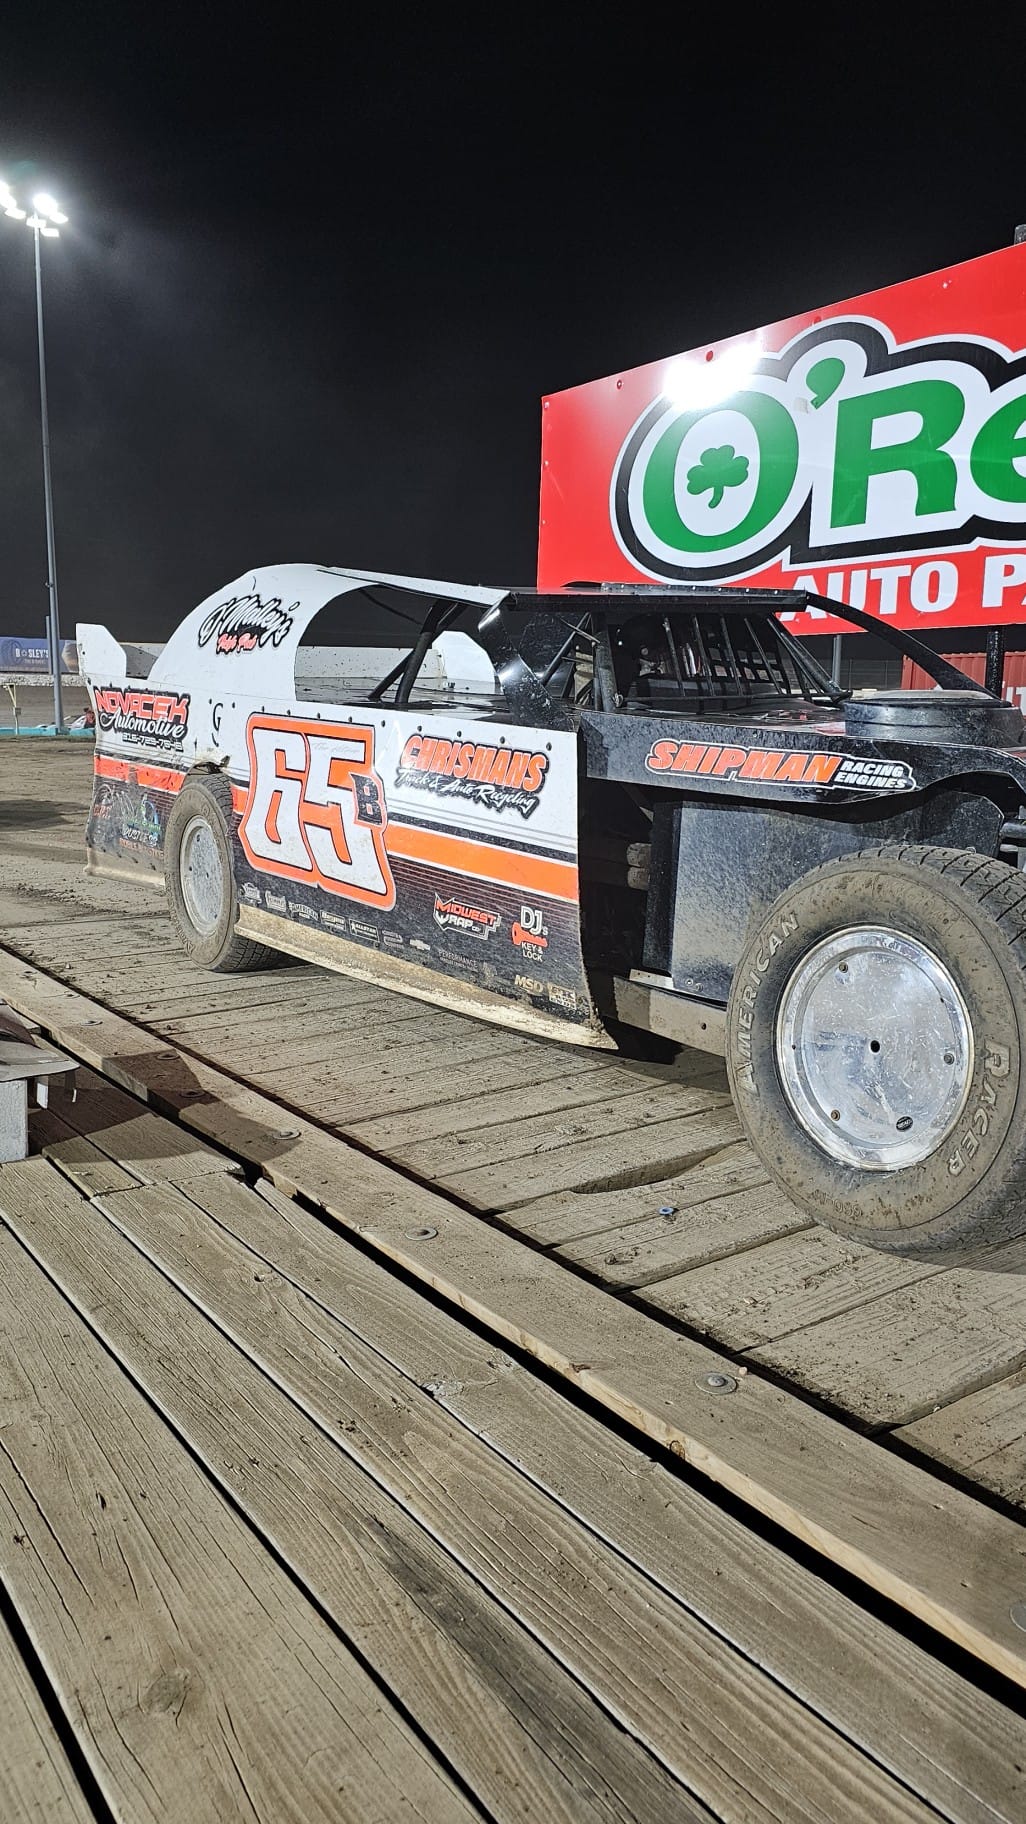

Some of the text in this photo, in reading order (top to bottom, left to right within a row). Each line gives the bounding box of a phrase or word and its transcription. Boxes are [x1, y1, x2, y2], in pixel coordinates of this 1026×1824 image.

[779, 554, 1026, 622] AUTO P
[94, 690, 189, 724] NOVACEK
[100, 706, 185, 738] Automotive
[400, 735, 548, 793] CHRISMANS
[648, 741, 842, 783] SHIPMAN
[840, 760, 905, 777] RACING
[396, 767, 539, 813] Truck & Auto Recycling
[834, 773, 908, 789] ENGINES
[435, 910, 474, 928] WRAP
[436, 900, 497, 925] MIDWEST
[521, 941, 544, 955] KEY &
[522, 949, 543, 963] LOCK
[514, 974, 544, 993] MSD
[735, 912, 800, 1097] AMERICAN
[947, 1039, 1011, 1177] RACER
